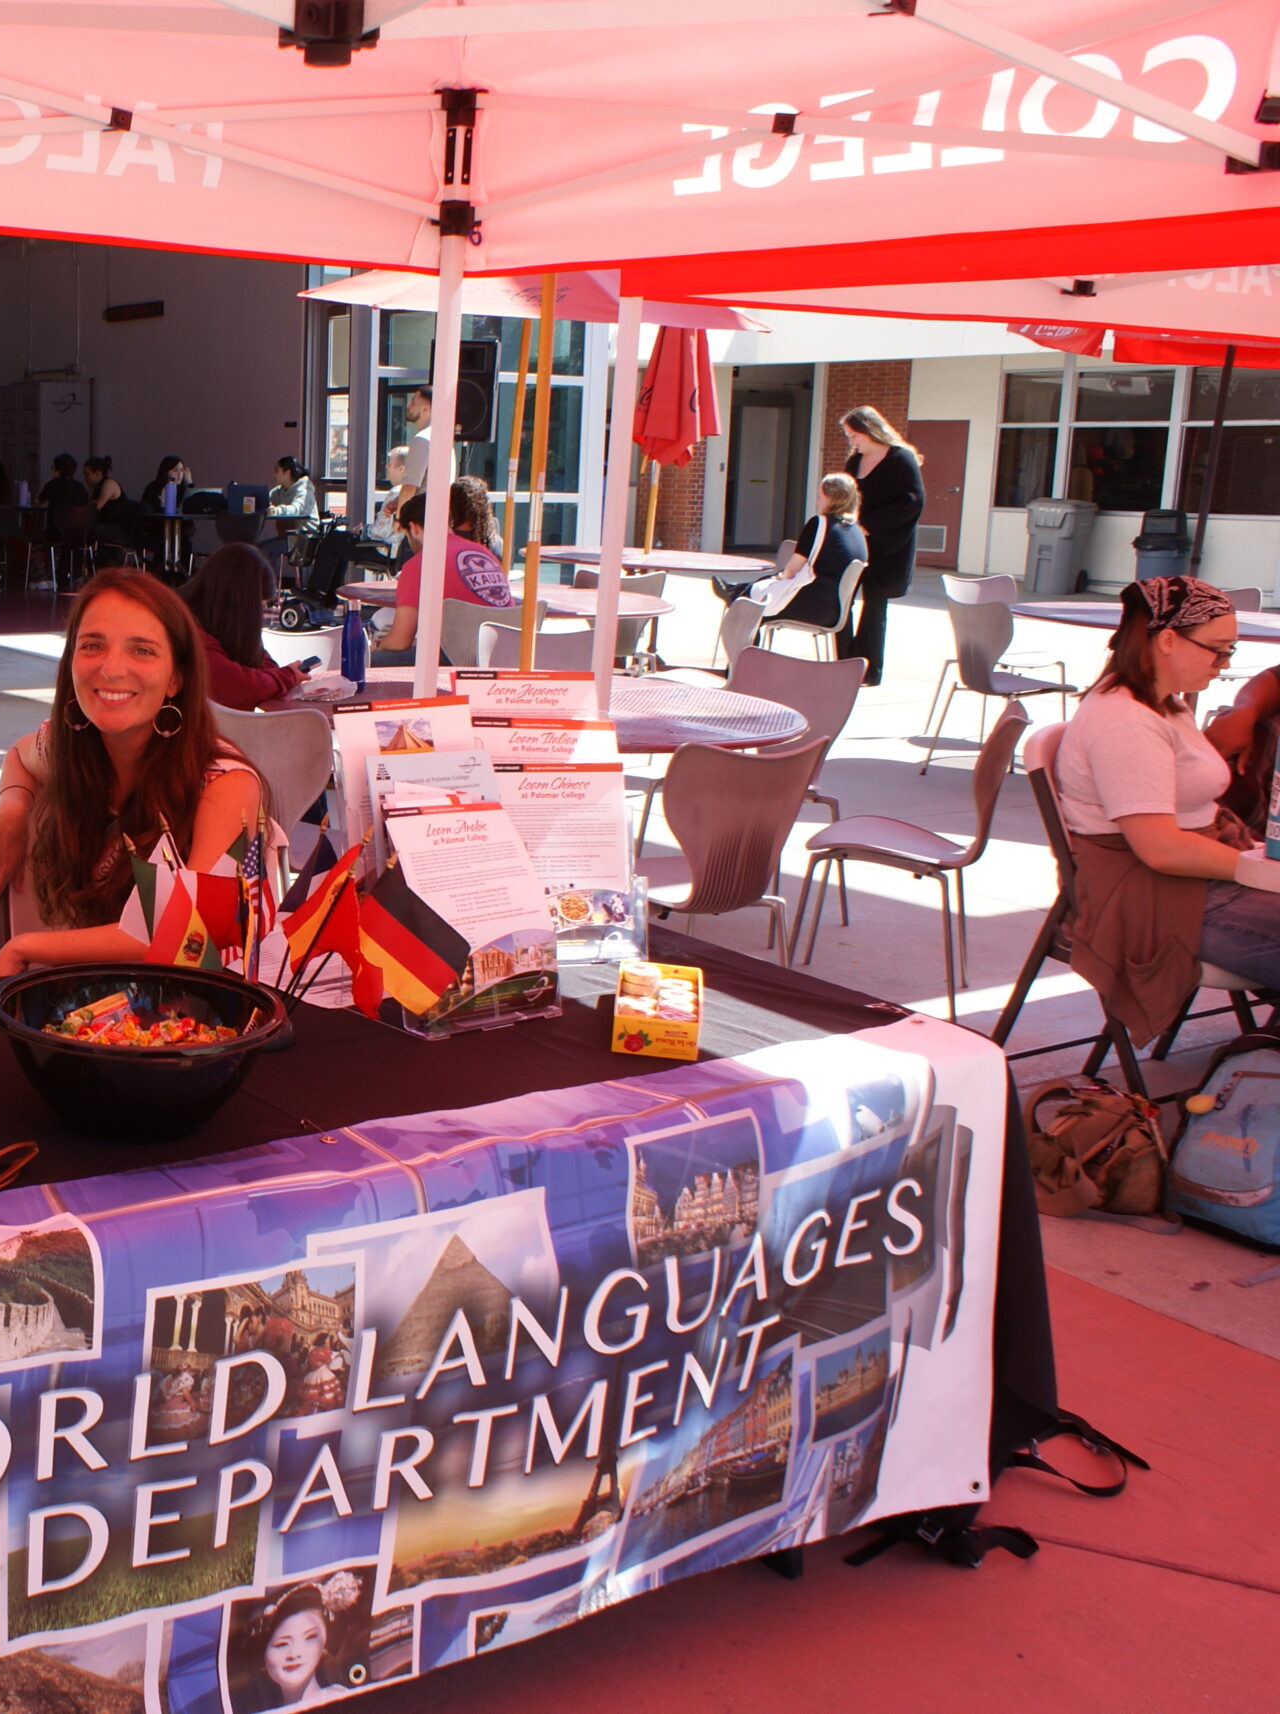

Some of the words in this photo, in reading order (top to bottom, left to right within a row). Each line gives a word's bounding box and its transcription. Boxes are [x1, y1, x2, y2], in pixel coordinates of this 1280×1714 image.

[487, 683, 518, 696] Learn
[517, 683, 569, 698] Japanese
[509, 732, 539, 744] Learn
[518, 777, 549, 791] Learn
[551, 777, 590, 790] Chinese
[531, 791, 558, 799] Palomar
[561, 791, 585, 800] College
[426, 824, 451, 837] Learn
[454, 819, 487, 834] Arabic
[352, 1178, 923, 1412] LANGUAGES
[27, 1314, 781, 1597] DEPARTMENT
